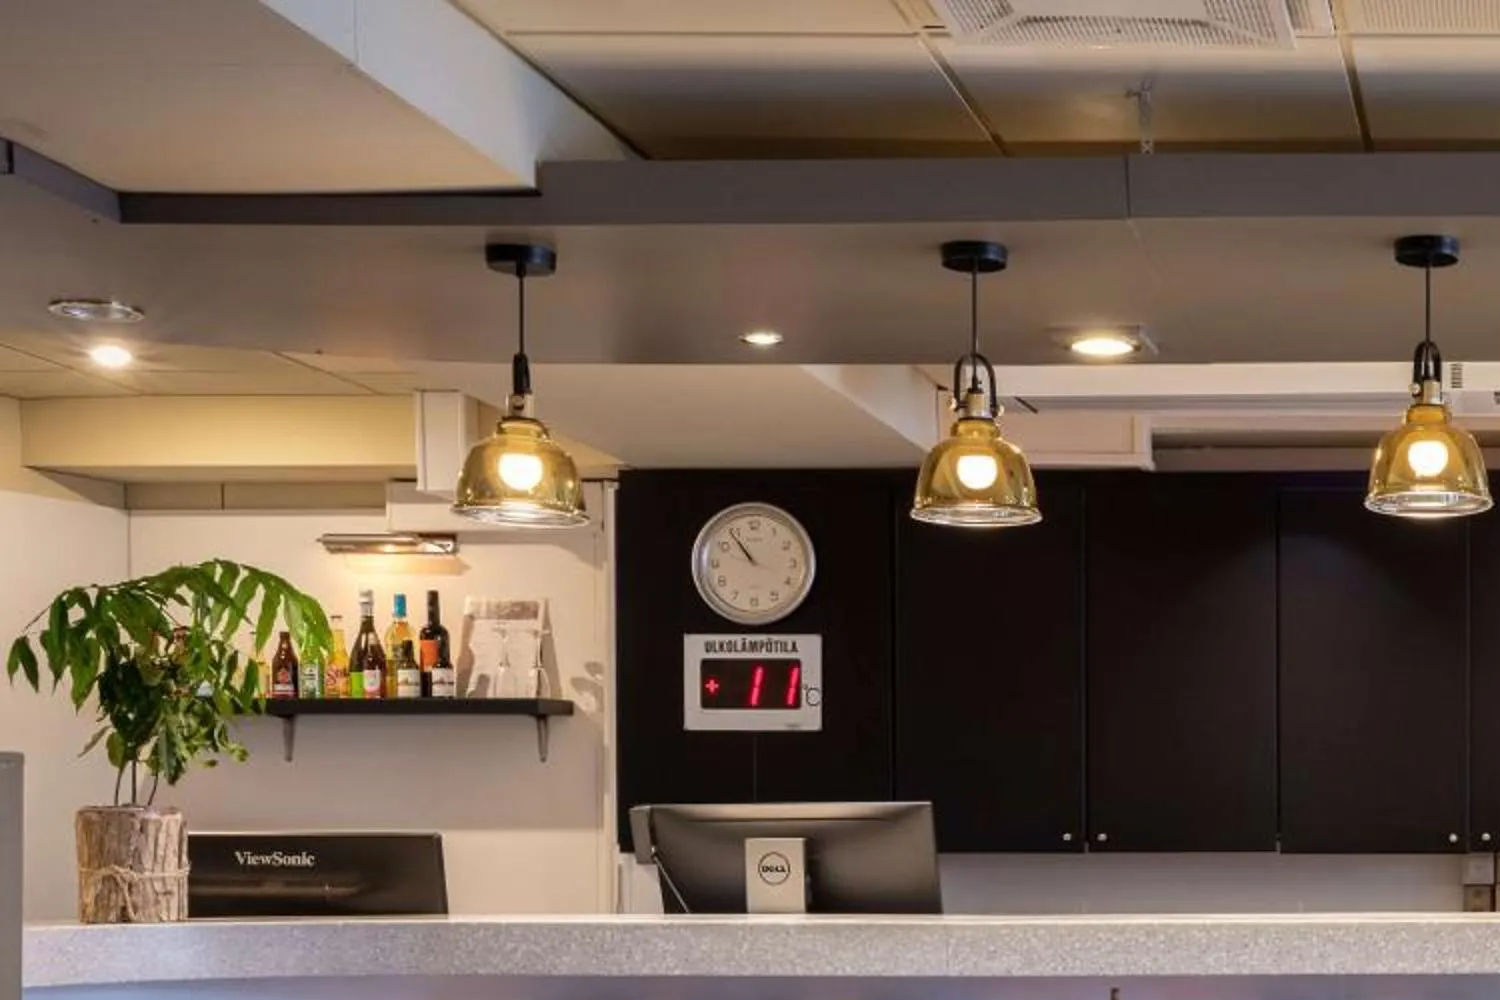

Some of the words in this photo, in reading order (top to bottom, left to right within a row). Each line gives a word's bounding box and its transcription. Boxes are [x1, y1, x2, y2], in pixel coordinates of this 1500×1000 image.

[704, 638, 799, 653] ULKOLÄMPÖTILA
[750, 666, 800, 707] 11
[235, 851, 315, 867] ViewSonic
